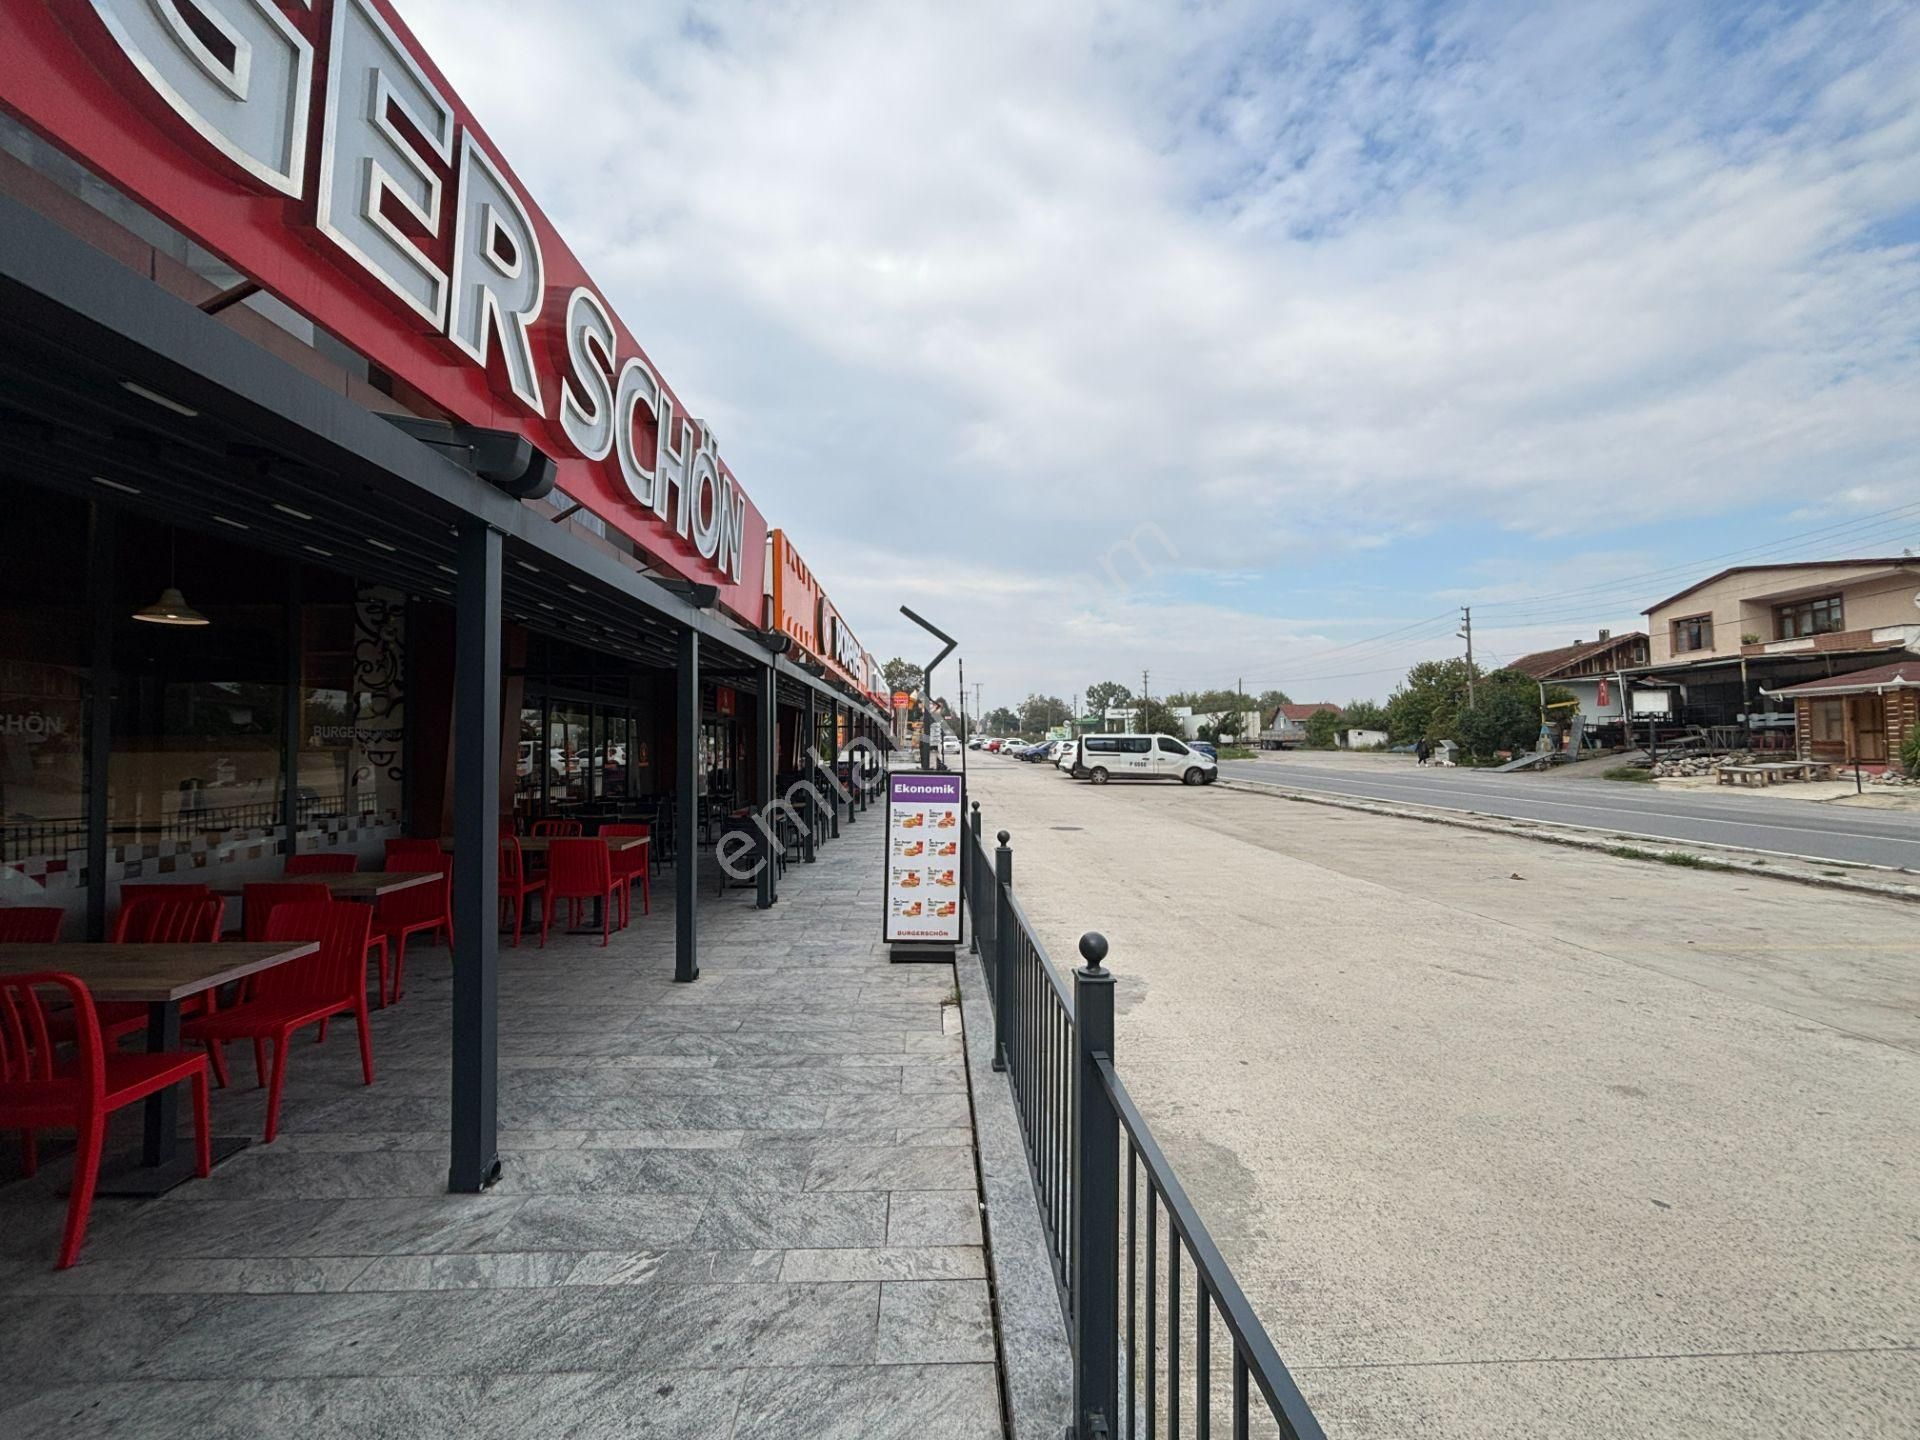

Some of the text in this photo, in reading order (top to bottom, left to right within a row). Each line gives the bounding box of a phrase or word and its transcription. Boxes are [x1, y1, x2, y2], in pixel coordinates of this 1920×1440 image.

[313, 725, 402, 739] BURGERS
[894, 783, 955, 794] Ekonomik
[897, 929, 949, 937] BURGERSCHÖN
